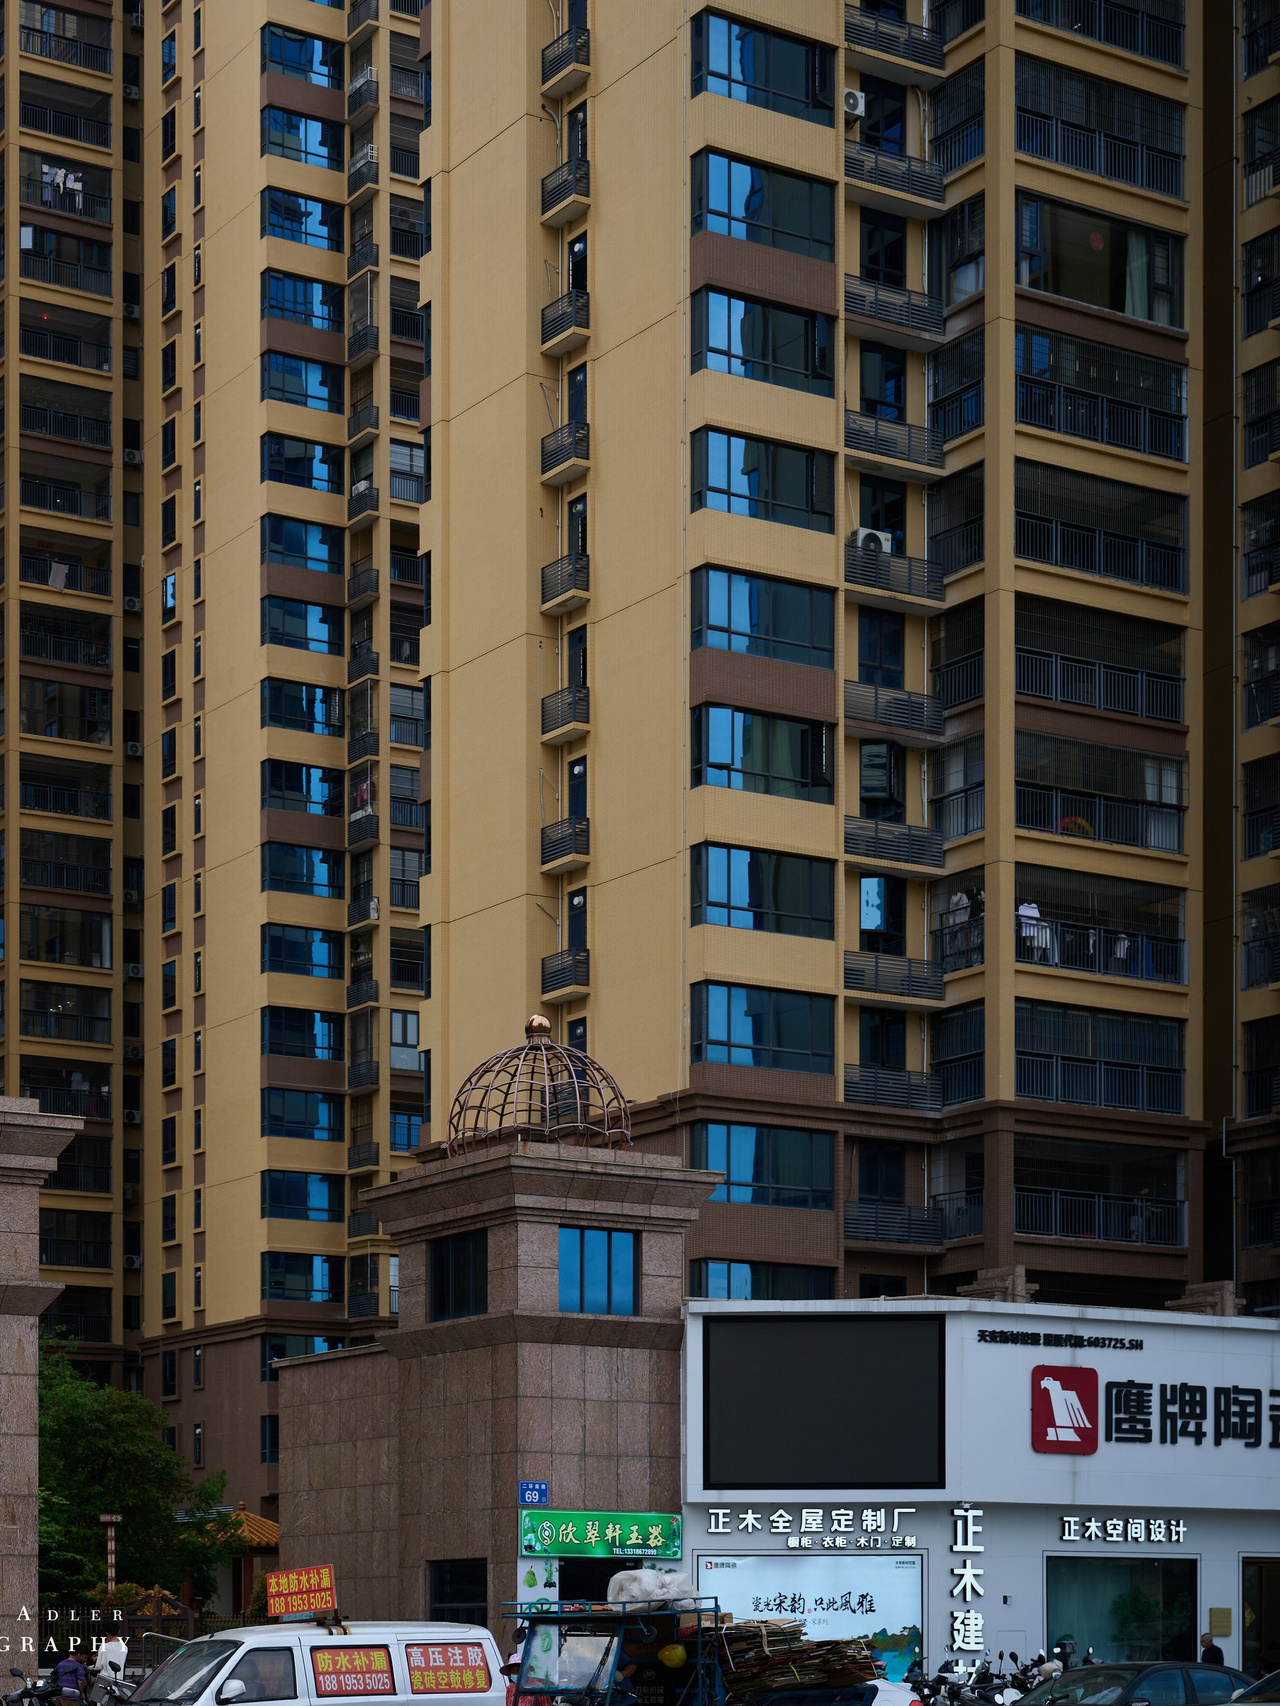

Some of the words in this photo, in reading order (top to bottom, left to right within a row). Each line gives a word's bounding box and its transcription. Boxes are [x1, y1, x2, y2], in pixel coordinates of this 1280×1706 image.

[1105, 1379, 1280, 1449] 鹰牌陶
[525, 1490, 539, 1502] 69
[707, 1508, 917, 1533] 正木全屋定制厂
[1060, 1516, 1188, 1543] 正木空间设计
[269, 1568, 331, 1595] 本地防水补漏
[270, 1597, 286, 1614] 188
[287, 1594, 308, 1612] 1953
[310, 1591, 332, 1609] 5025
[316, 1651, 388, 1672] 防水补漏
[407, 1646, 484, 1668] 高压注胶
[319, 1674, 337, 1691] 188
[339, 1673, 364, 1690] 1953
[366, 1673, 390, 1690] 5025
[411, 1669, 488, 1690] 瓷砖空鼓修复
